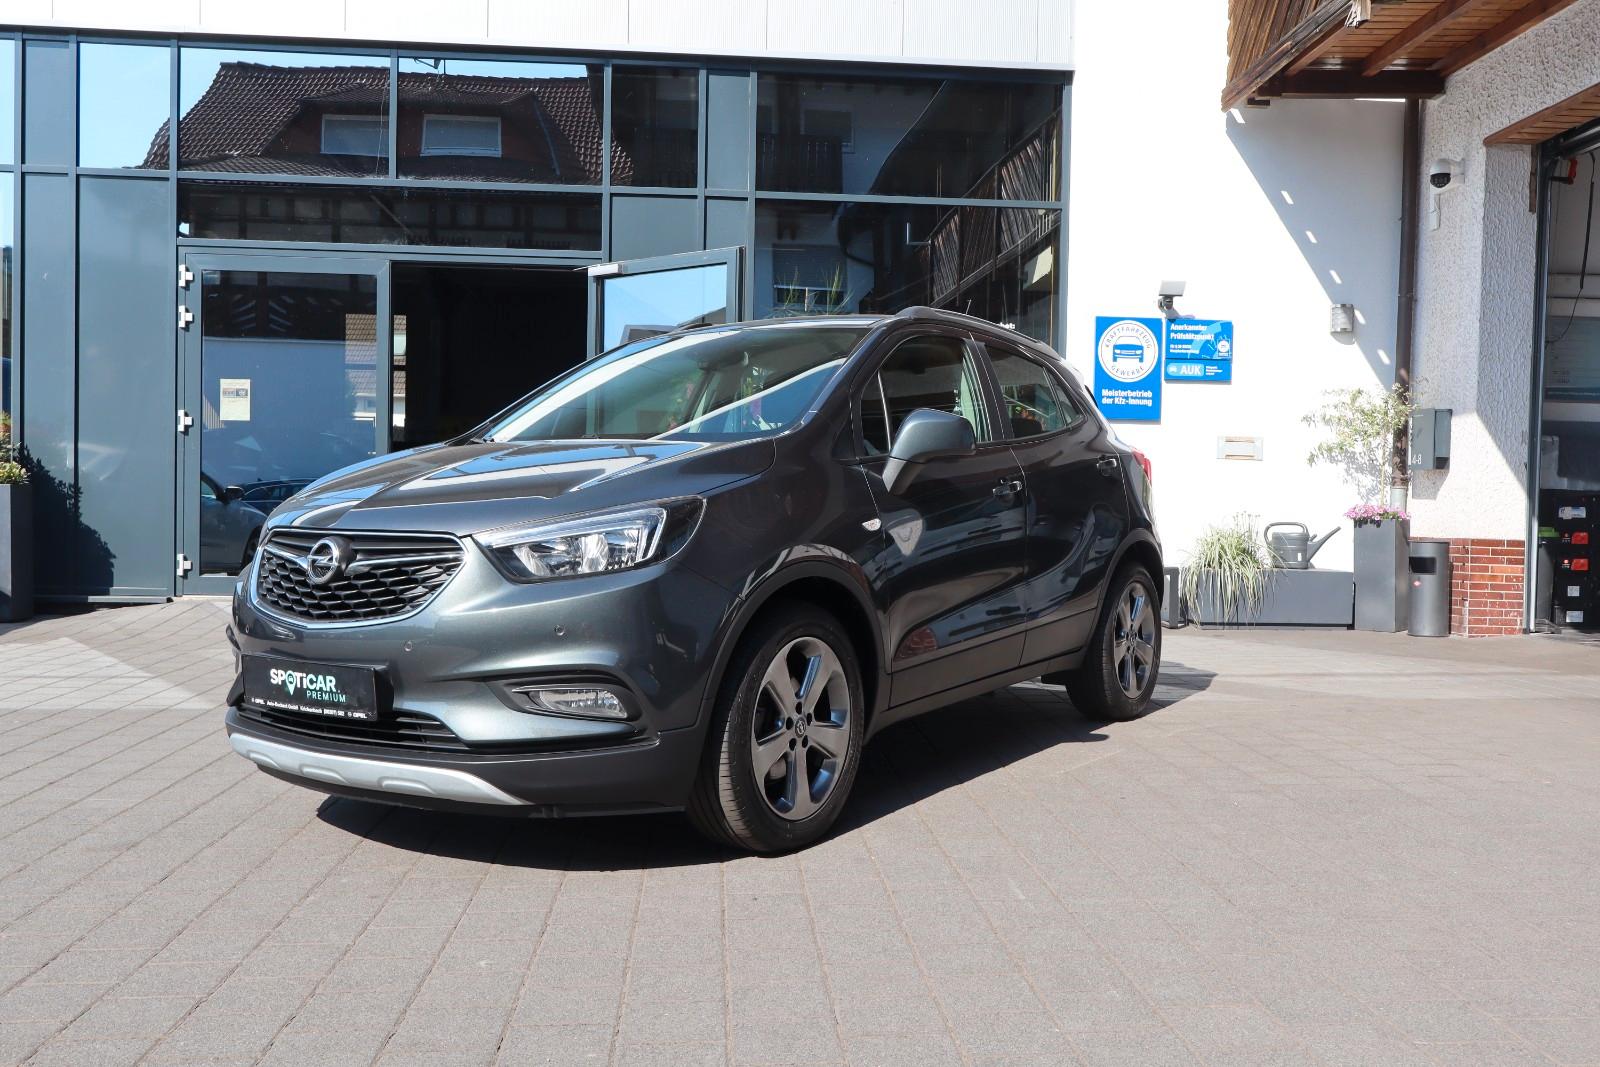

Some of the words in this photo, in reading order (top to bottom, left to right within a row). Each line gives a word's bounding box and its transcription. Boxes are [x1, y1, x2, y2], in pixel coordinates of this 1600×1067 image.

[1181, 365, 1201, 375] AUK
[1102, 389, 1152, 397] Meisterbetrieb
[1102, 397, 1114, 405] der
[306, 690, 346, 703] PREMIUM
